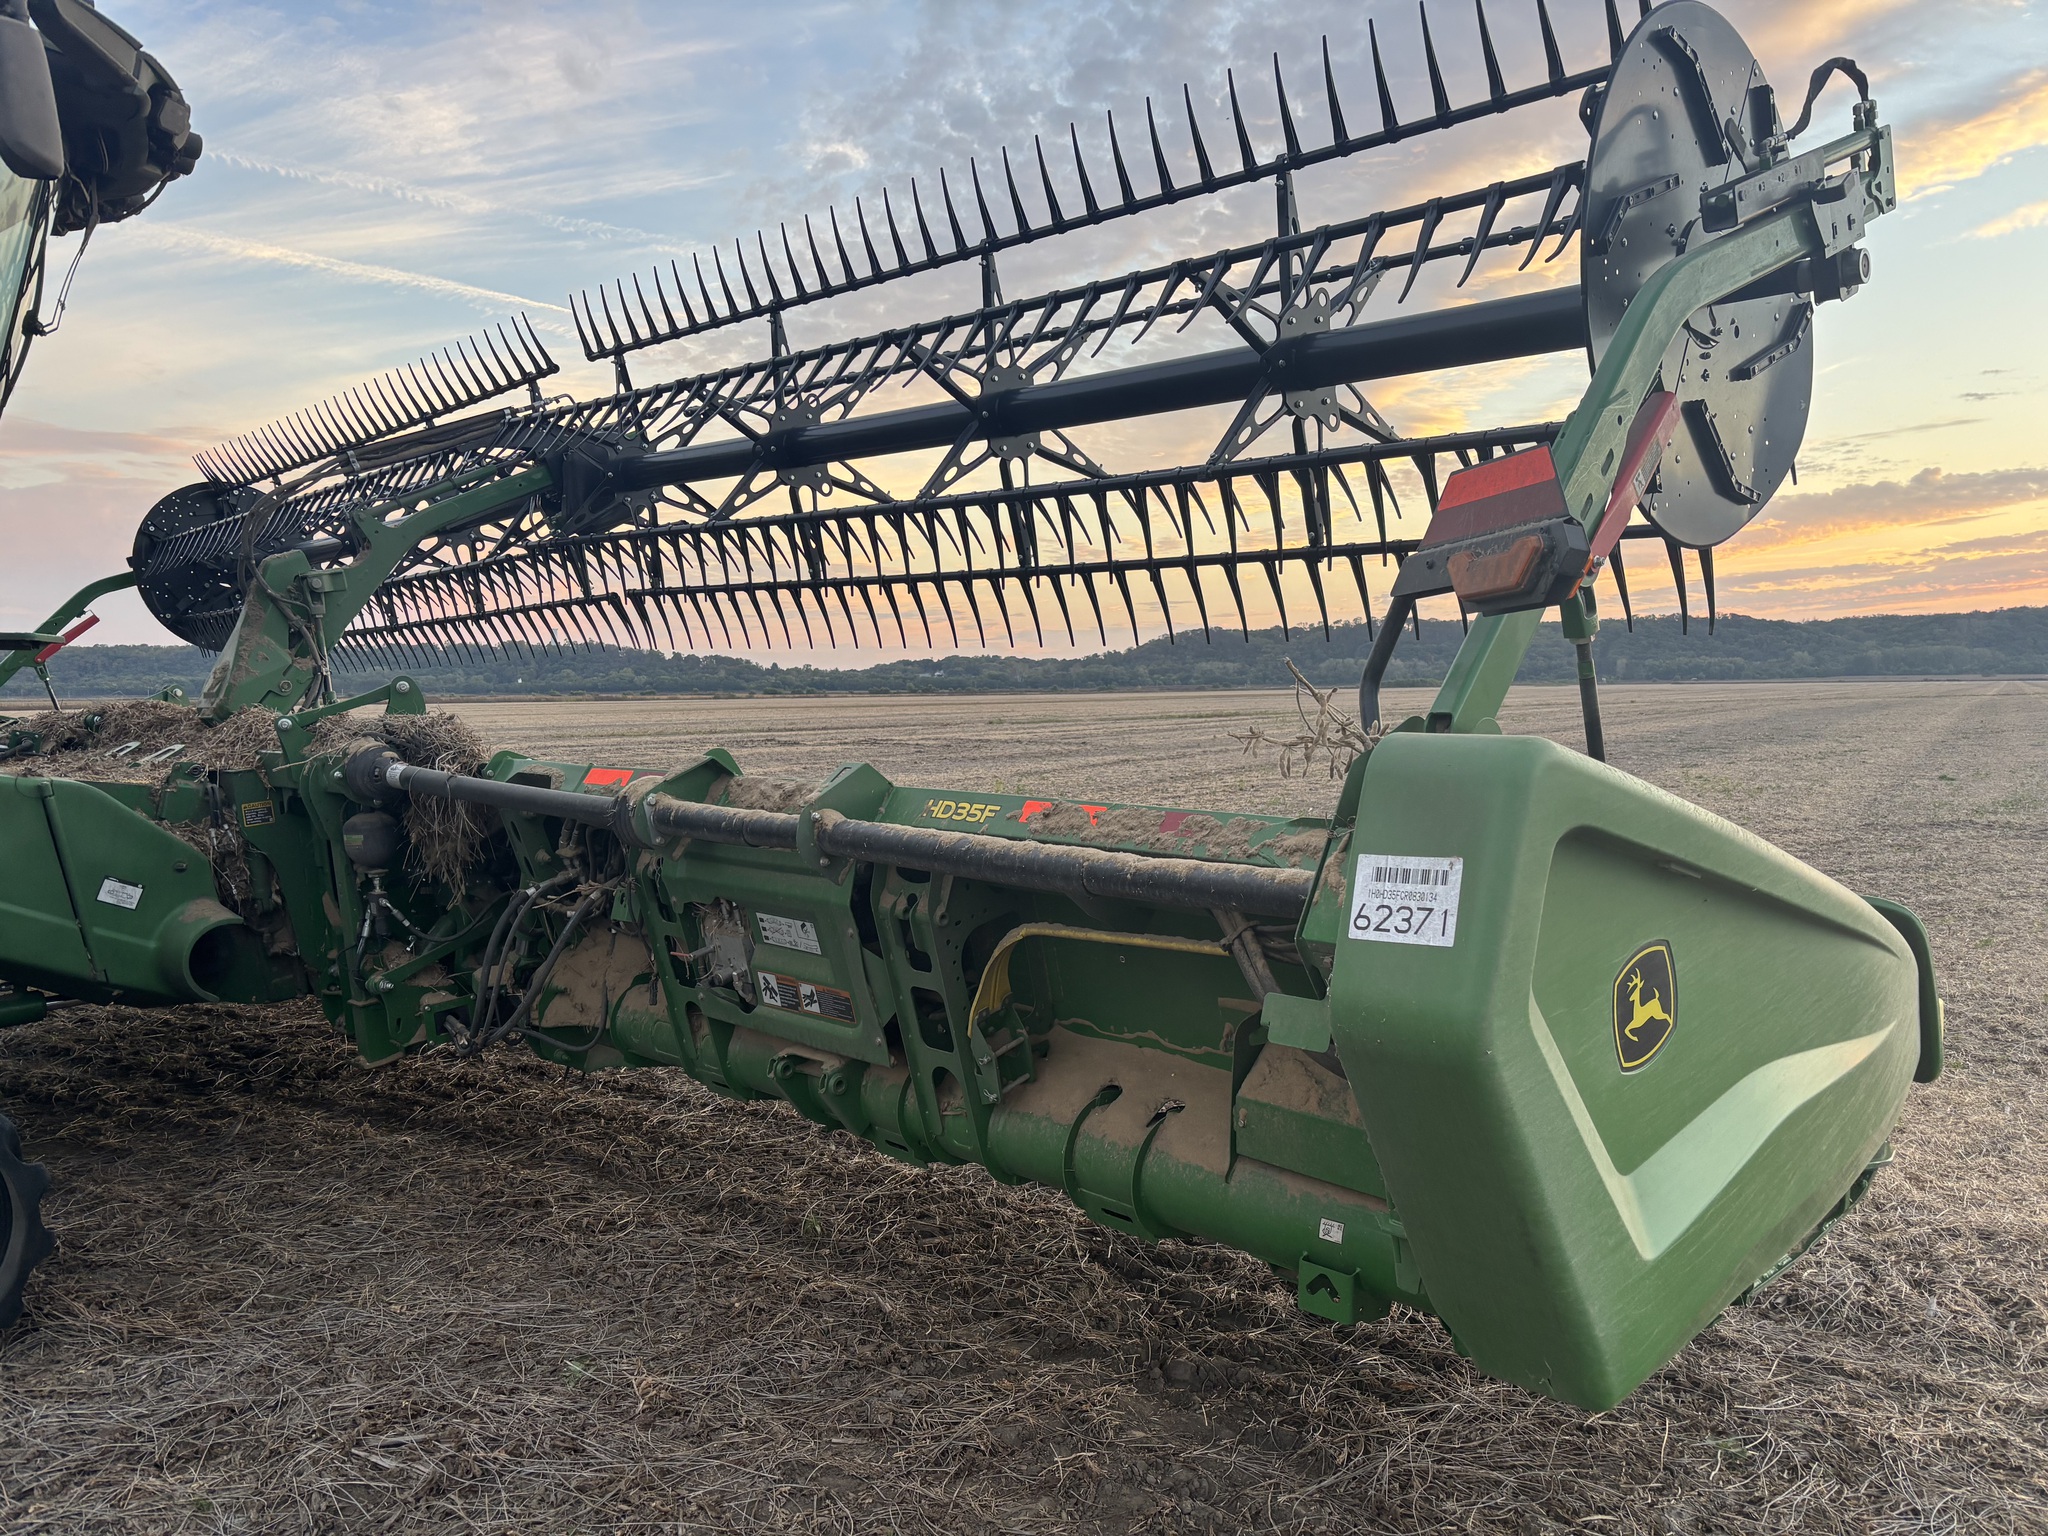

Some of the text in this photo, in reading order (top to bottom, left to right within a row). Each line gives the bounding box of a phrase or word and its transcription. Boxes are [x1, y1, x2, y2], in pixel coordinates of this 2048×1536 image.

[247, 801, 272, 809] CAUTION
[922, 798, 1002, 824] HD35F
[1353, 903, 1449, 937] 62371
